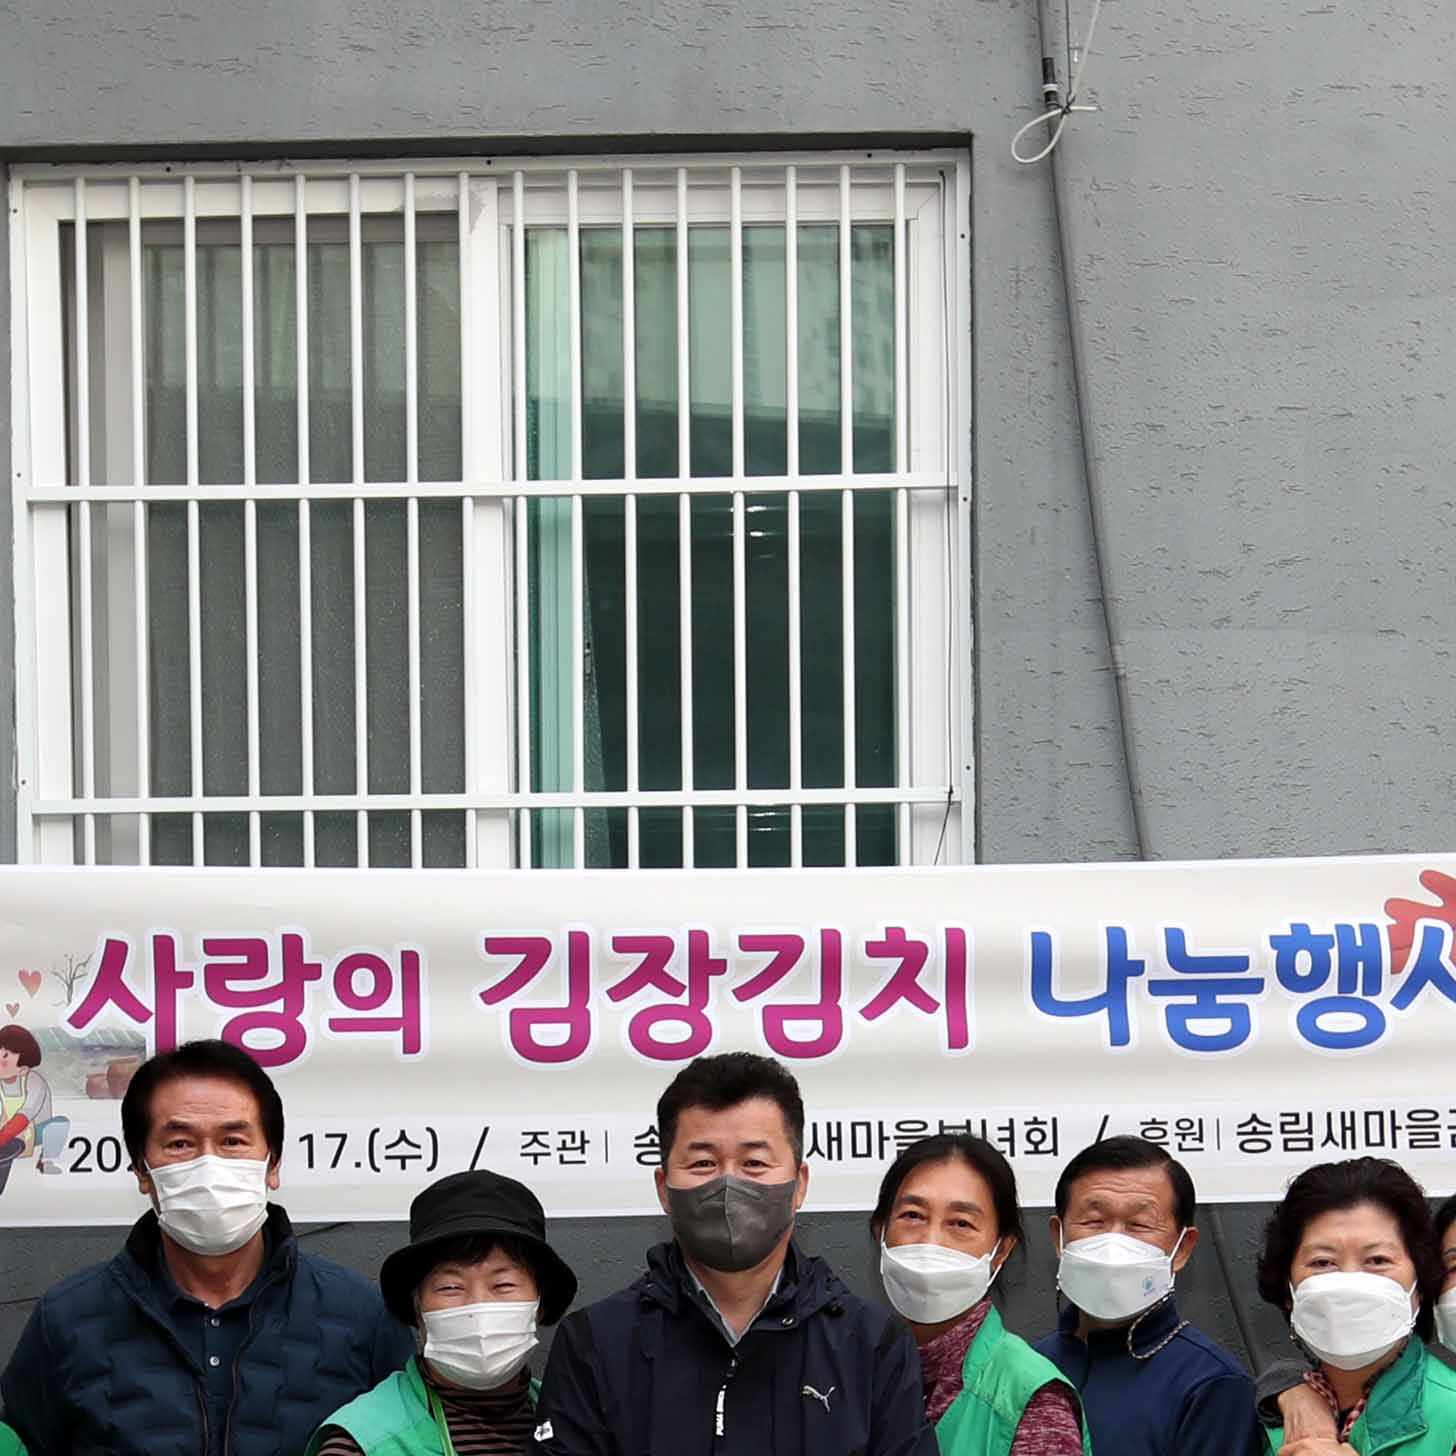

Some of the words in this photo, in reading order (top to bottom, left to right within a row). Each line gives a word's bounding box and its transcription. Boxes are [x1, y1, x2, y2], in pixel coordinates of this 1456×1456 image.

[66, 932, 420, 1066] 사랑의
[478, 927, 975, 1064] 김장김치
[297, 1126, 440, 1173] 17.(수)
[519, 1129, 591, 1166] 주관
